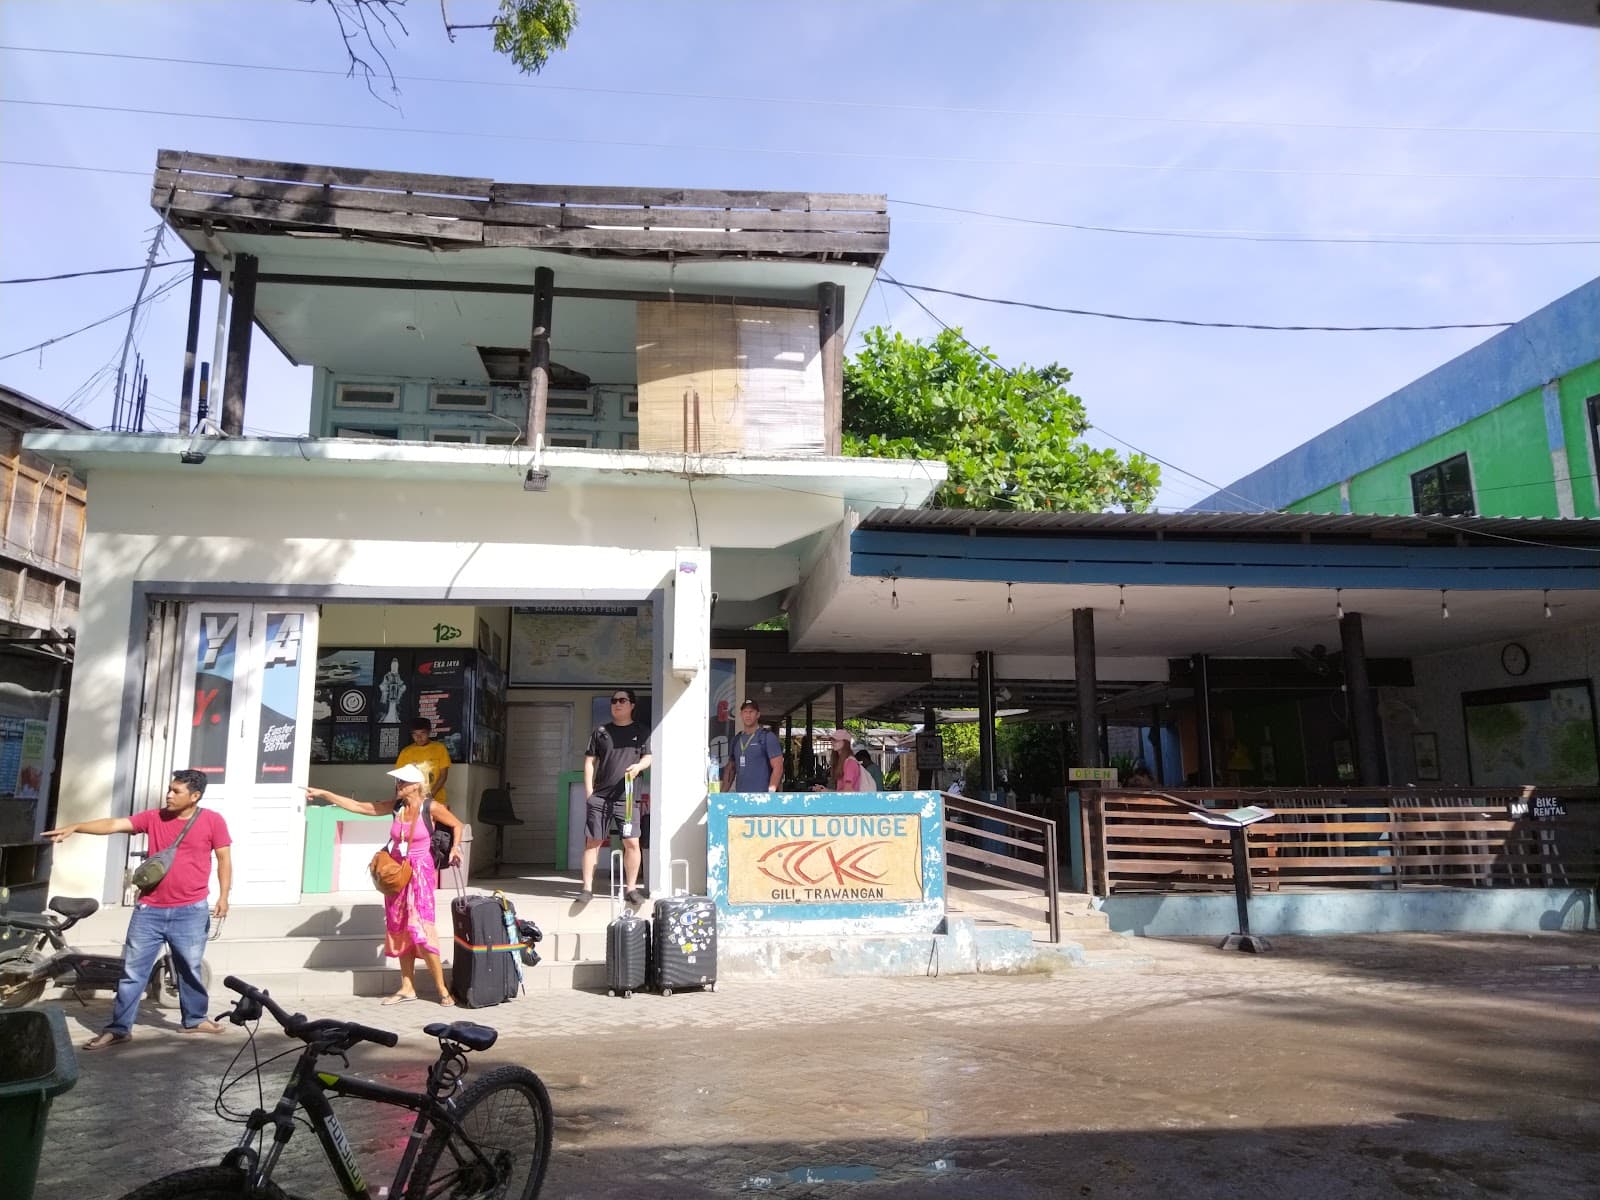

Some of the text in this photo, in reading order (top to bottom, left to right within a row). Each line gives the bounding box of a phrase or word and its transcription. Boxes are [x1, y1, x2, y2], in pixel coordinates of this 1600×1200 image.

[1075, 770, 1111, 779] OPEN
[1536, 797, 1558, 807] BIKE
[1533, 807, 1566, 817] RENTAL
[741, 817, 907, 838] JUKU LOUNGE
[771, 888, 884, 900] GILI TRAWANGAN
